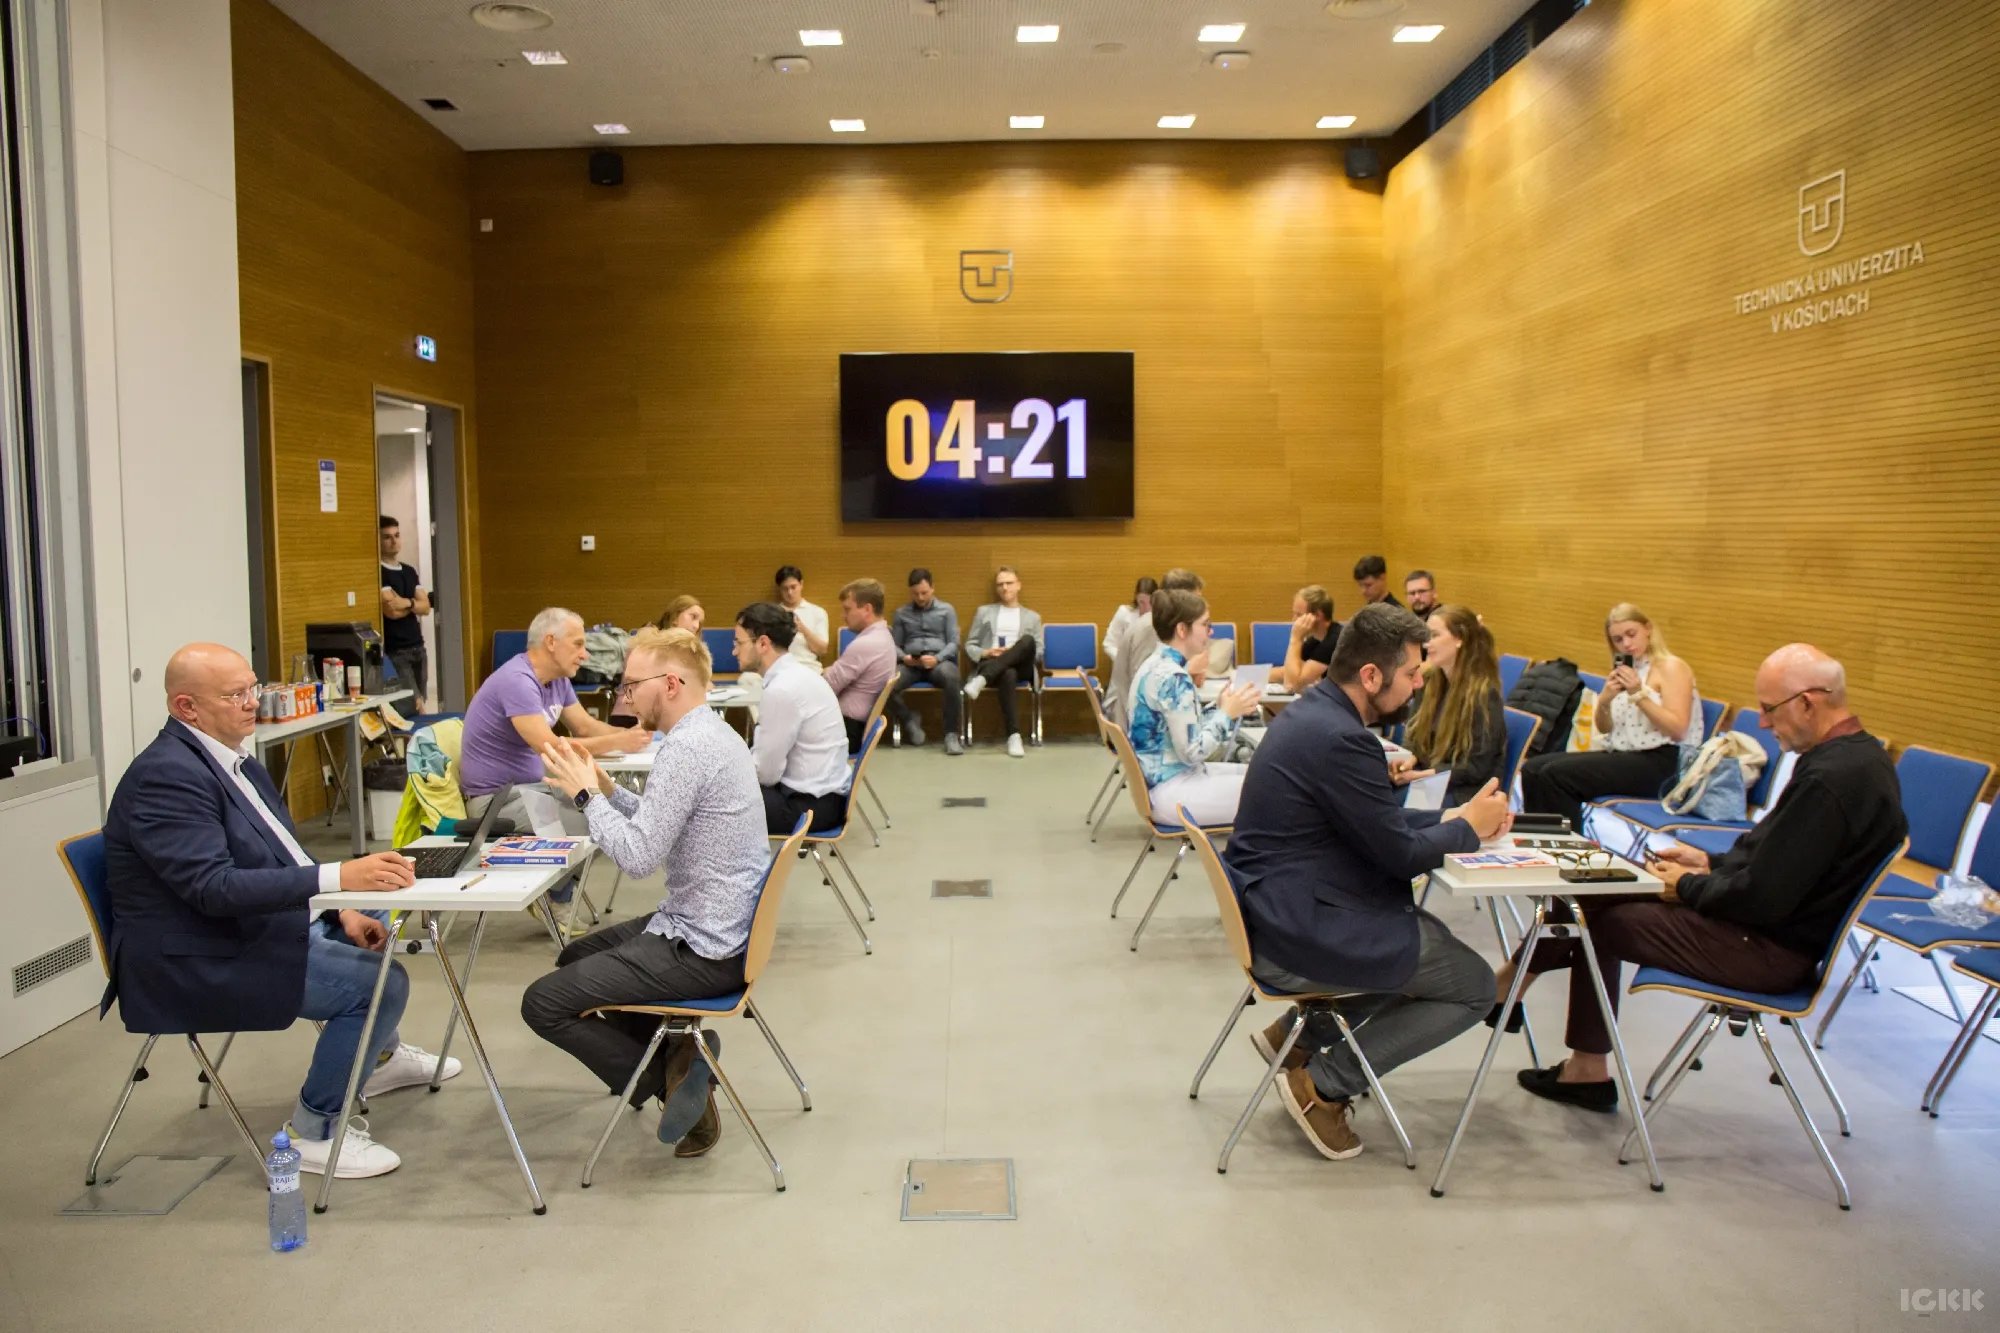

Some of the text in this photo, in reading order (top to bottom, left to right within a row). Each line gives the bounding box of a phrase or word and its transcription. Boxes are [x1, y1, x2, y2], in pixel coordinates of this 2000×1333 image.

[1818, 241, 1925, 292] UNIVERZITA
[1771, 288, 1870, 334] V KOŠICIACH
[886, 398, 1087, 481] 04:21
